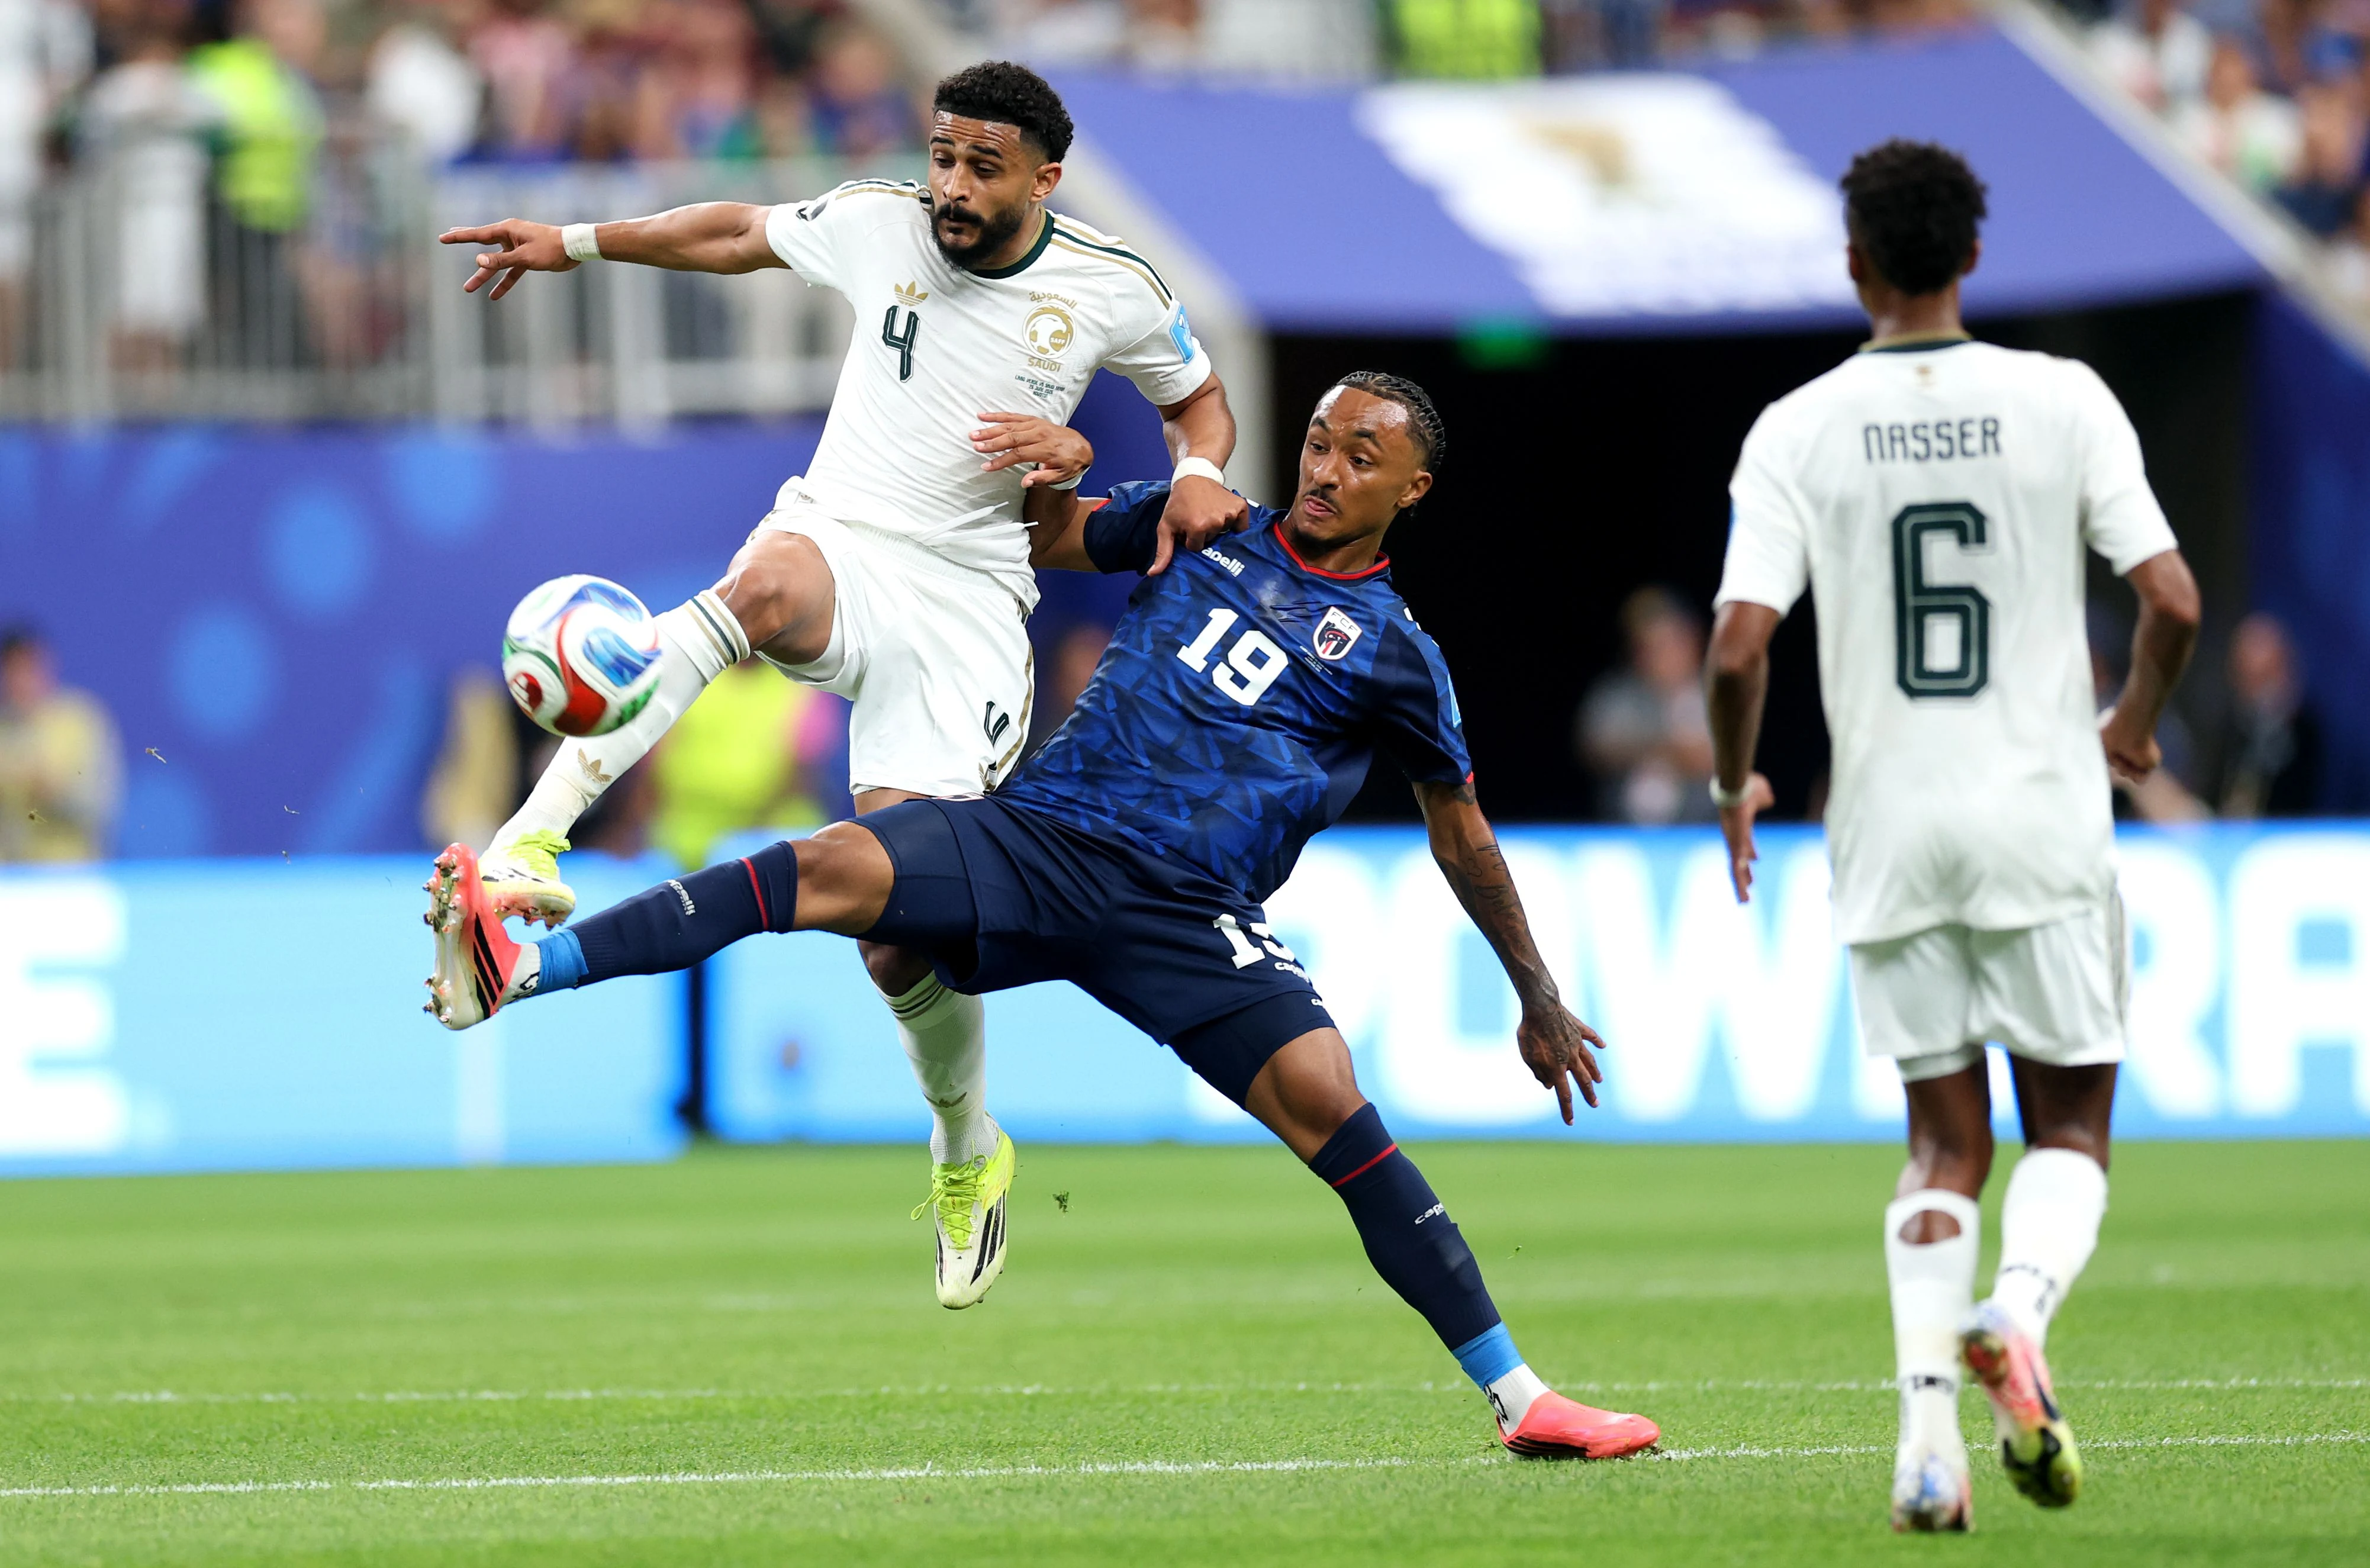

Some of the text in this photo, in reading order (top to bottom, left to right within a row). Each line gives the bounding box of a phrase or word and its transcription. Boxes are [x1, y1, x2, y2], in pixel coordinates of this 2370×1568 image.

[1029, 291, 1078, 309] السعودية
[882, 305, 920, 382] 4
[1028, 357, 1061, 372] SAUDI
[1863, 417, 2004, 464] NASSER
[1331, 611, 1358, 632] FCF
[1890, 501, 1990, 700] 6
[1176, 608, 1289, 706] 19
